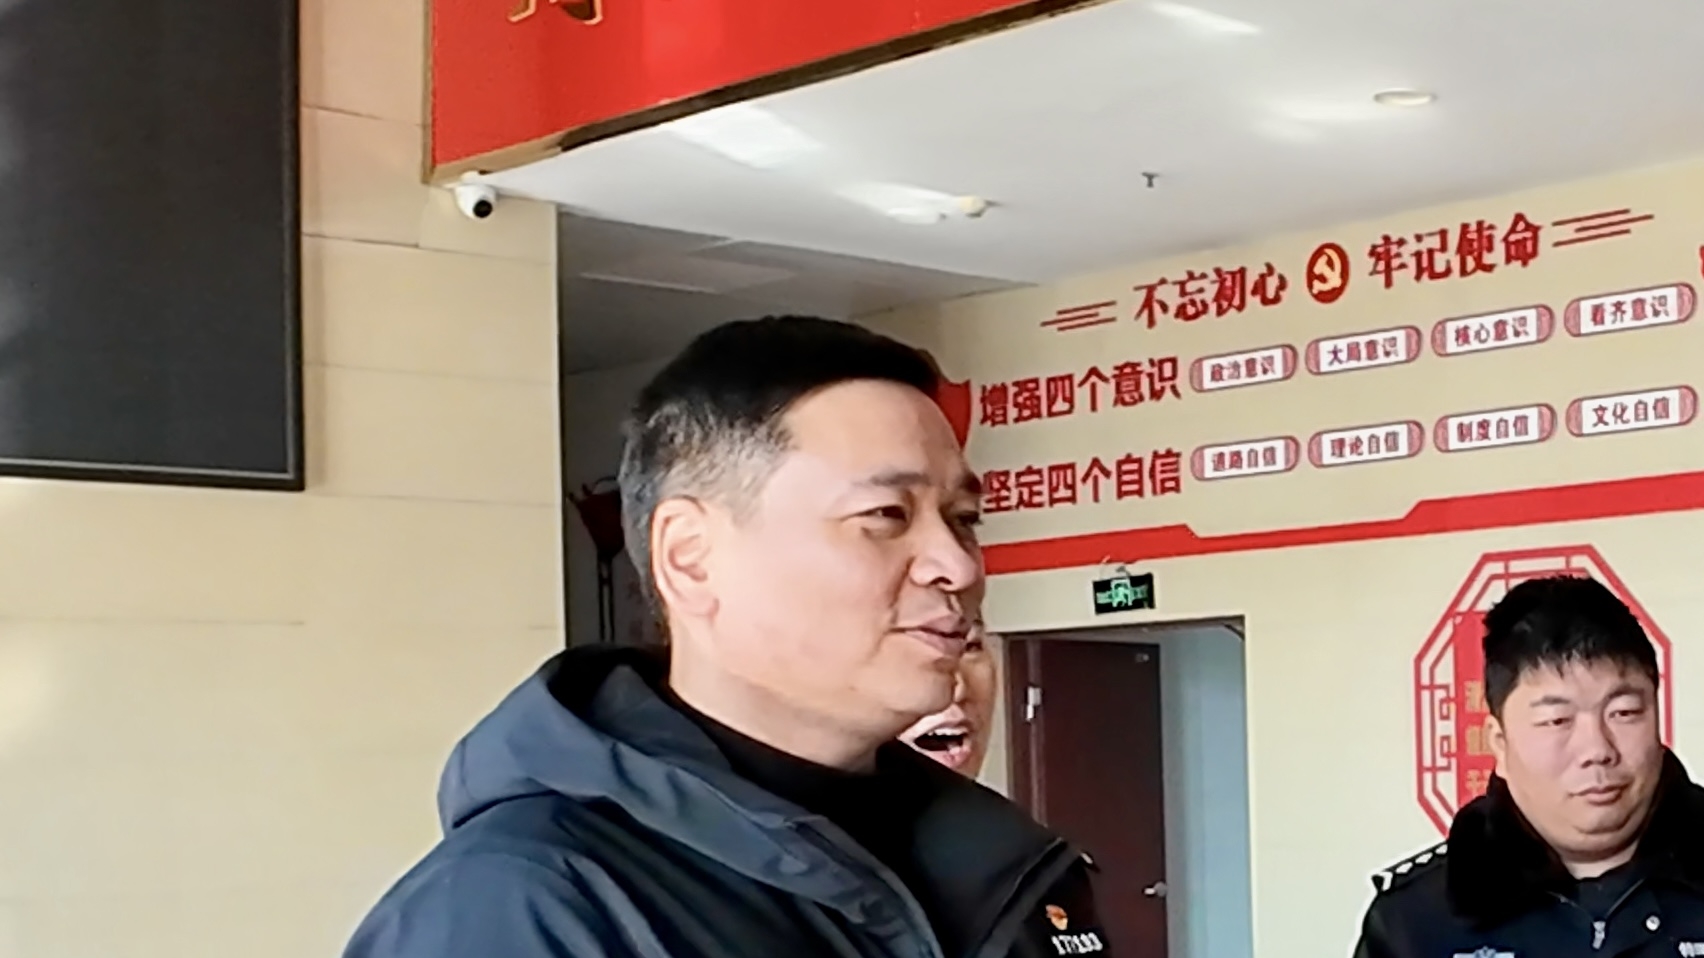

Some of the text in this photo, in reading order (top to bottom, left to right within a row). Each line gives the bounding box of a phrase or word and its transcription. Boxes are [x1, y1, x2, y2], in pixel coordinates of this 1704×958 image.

[1133, 212, 1542, 329] 不忘初心 牢记使命
[1590, 294, 1669, 327] 看齐意识
[1454, 316, 1529, 347] 核心意识
[1327, 336, 1399, 366] 大局意识
[1210, 355, 1276, 383] 政治意识
[979, 356, 1181, 427] 增强四个意识
[1592, 396, 1670, 427] 文化自信
[1457, 414, 1529, 443] 制度自信
[1212, 446, 1276, 472] 道路自信
[1330, 430, 1400, 459] 理论自信
[982, 447, 1182, 514] 坚定四个自信
